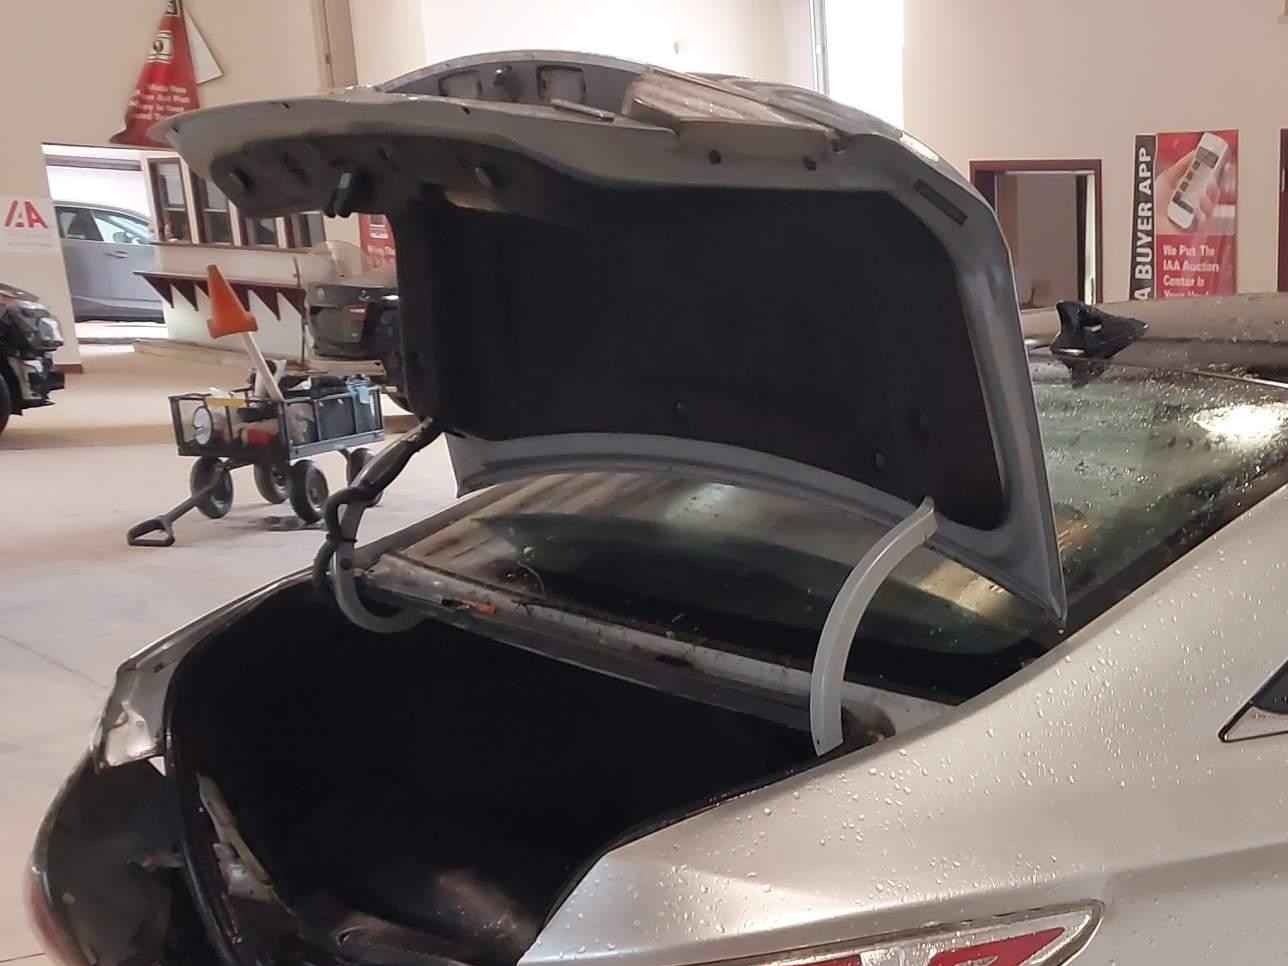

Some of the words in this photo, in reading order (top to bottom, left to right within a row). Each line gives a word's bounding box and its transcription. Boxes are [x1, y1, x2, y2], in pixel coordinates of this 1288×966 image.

[1138, 147, 1152, 195] APP
[1134, 202, 1153, 280] BUYER
[1163, 259, 1180, 271] IAA
[1182, 260, 1220, 272] Auction
